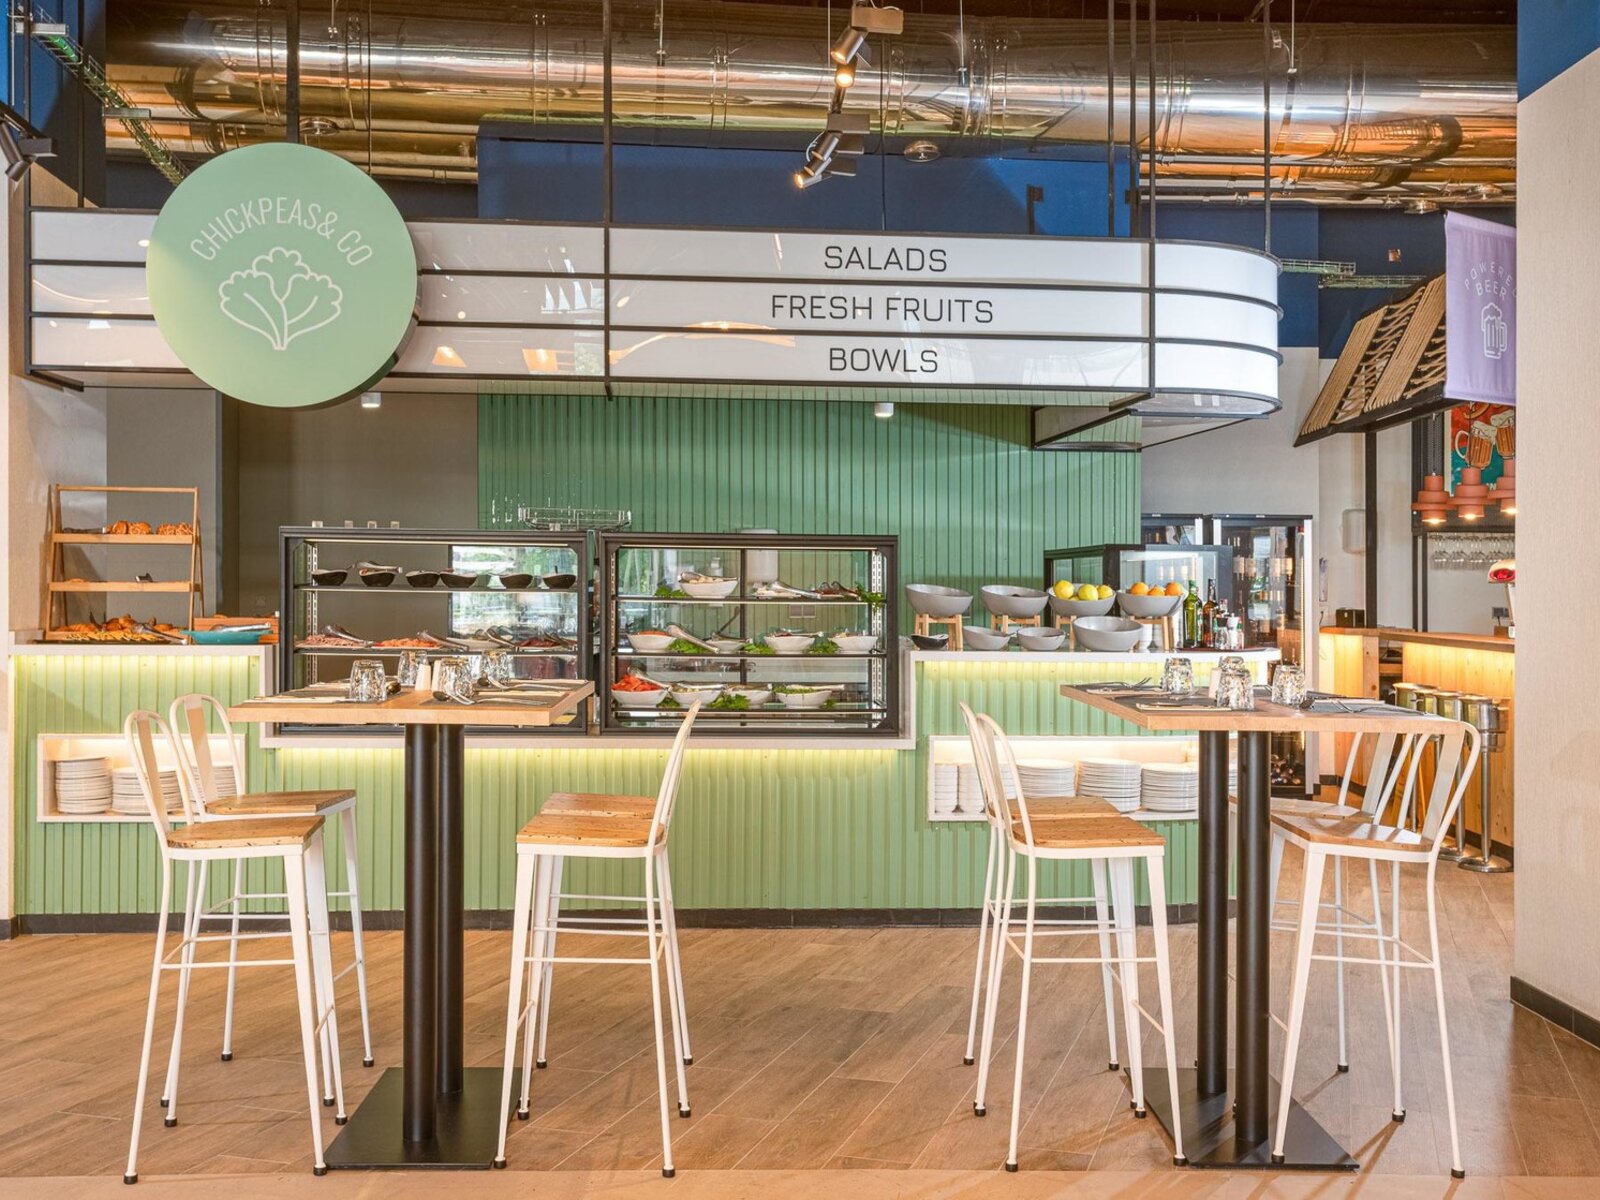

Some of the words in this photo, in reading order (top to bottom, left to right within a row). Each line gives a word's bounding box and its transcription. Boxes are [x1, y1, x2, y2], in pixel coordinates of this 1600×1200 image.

[336, 229, 373, 266] CO
[824, 245, 947, 273] SALADS
[1475, 279, 1508, 301] BEER
[771, 295, 872, 321] FRESH
[886, 297, 993, 323] FRUITS
[829, 347, 938, 373] BOWLS
